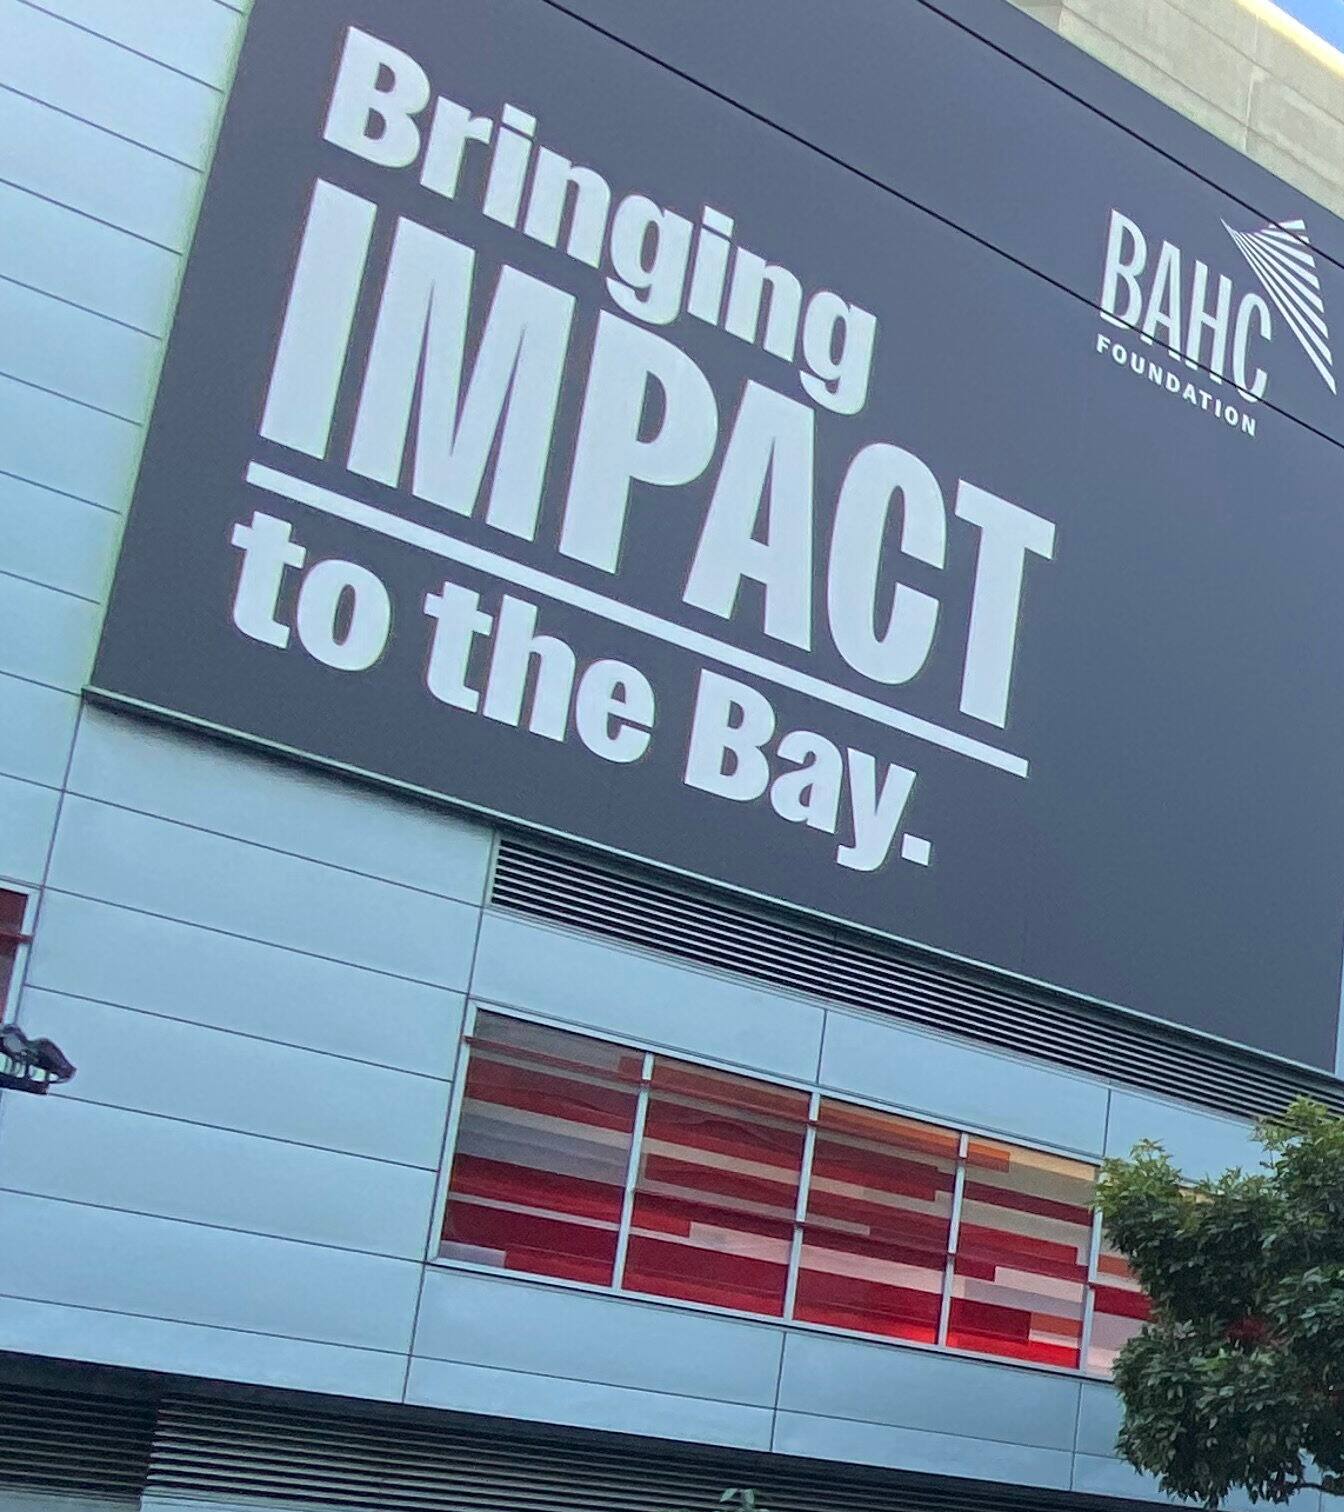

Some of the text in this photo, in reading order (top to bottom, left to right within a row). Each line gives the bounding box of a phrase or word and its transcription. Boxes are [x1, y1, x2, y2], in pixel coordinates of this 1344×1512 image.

[322, 25, 876, 415] Bringing
[1097, 333, 1257, 437] FOUNDATION
[1100, 208, 1272, 403] BAHC
[258, 178, 1055, 729] IMPACT
[230, 511, 931, 873] to the Bay.
